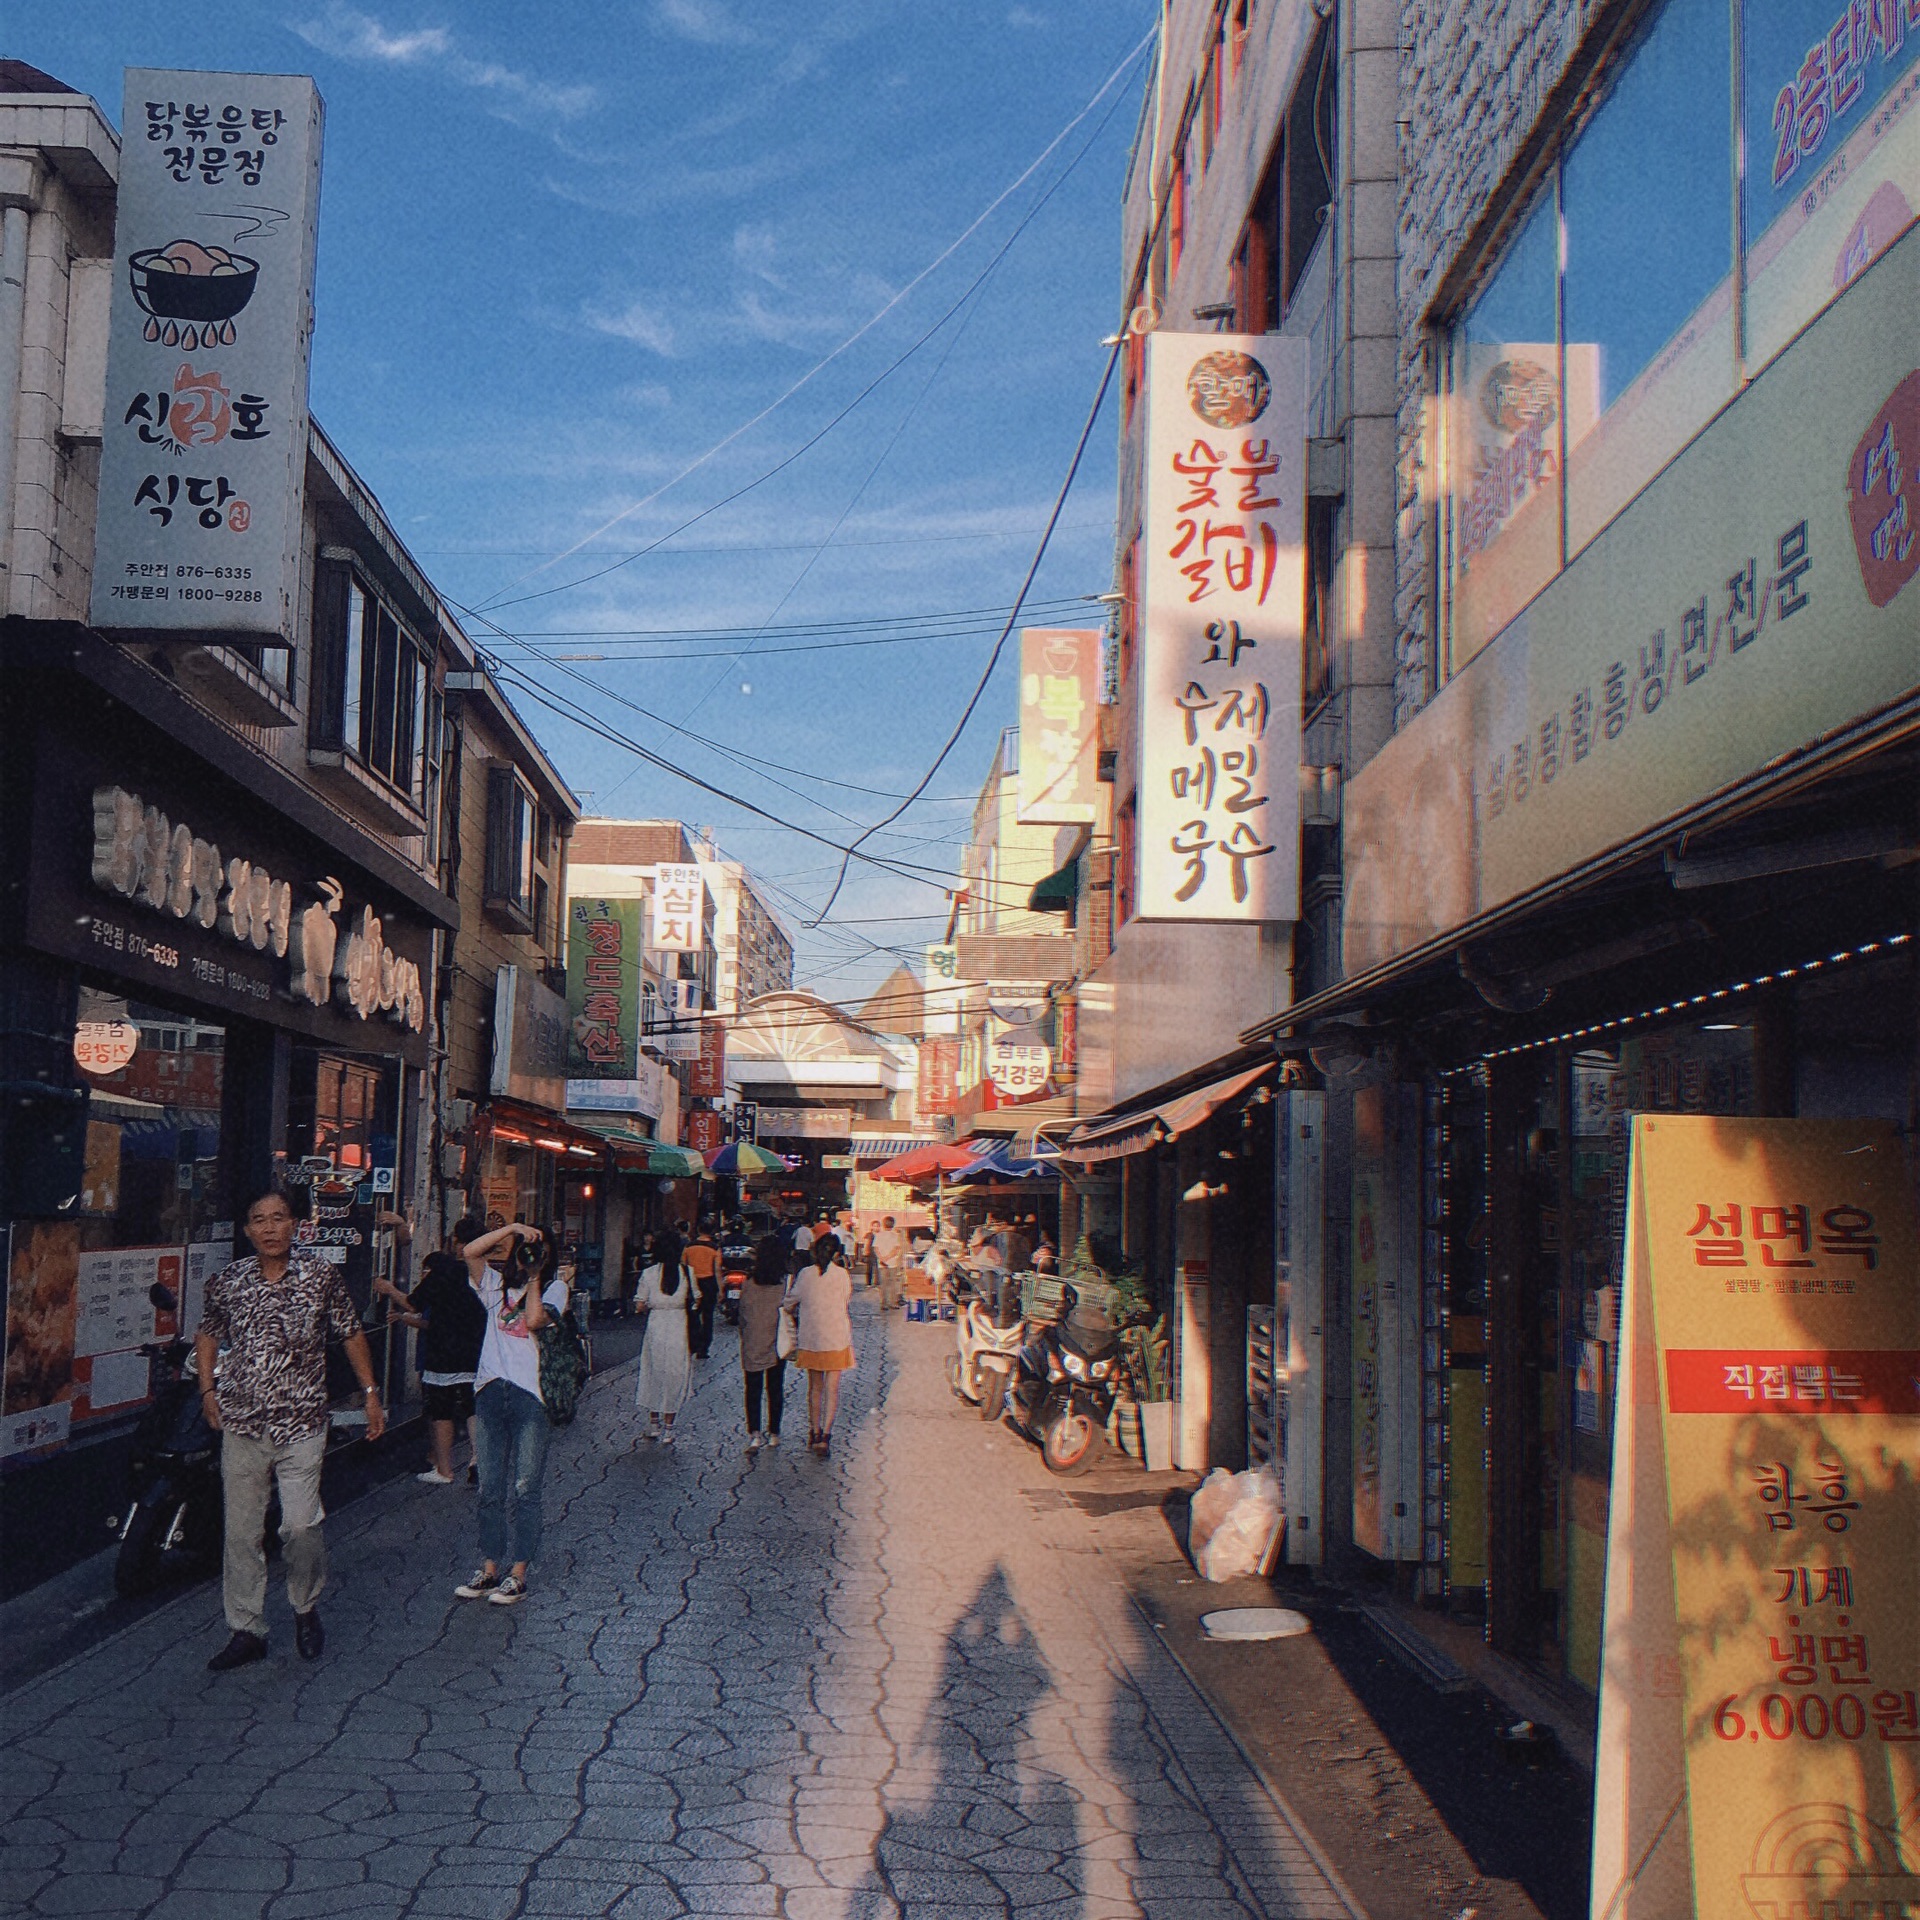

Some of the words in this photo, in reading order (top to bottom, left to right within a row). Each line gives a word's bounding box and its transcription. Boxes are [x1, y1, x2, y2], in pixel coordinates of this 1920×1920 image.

[144, 101, 288, 146] 닭볶음탕
[163, 146, 265, 186] 전문점
[1172, 438, 1281, 512] 숯불
[134, 474, 237, 529] 식당
[124, 563, 169, 578] 주안점
[176, 566, 252, 580] 876-6335
[1169, 518, 1279, 607] 갈비
[111, 586, 169, 600] 가맹문의
[177, 588, 263, 603] 1800-9288
[1201, 618, 1257, 668] 와
[1172, 681, 1271, 746] 수제
[1171, 744, 1269, 813] 메밀
[660, 868, 700, 883] 동인천
[1171, 820, 1277, 903] 국수
[91, 918, 125, 951] 주안점
[128, 933, 179, 969] 876-6335
[661, 888, 699, 948] 삼치
[584, 918, 623, 1064] 청도축산
[991, 1065, 1046, 1085] 건강원
[696, 1117, 712, 1150] 인삼
[1686, 1203, 1880, 1270] 설면옥
[1752, 1461, 1862, 1533] 함흥
[1774, 1565, 1853, 1606] 기계
[1769, 1634, 1873, 1685] 냉면
[1713, 1689, 1920, 1743] 6,000원
